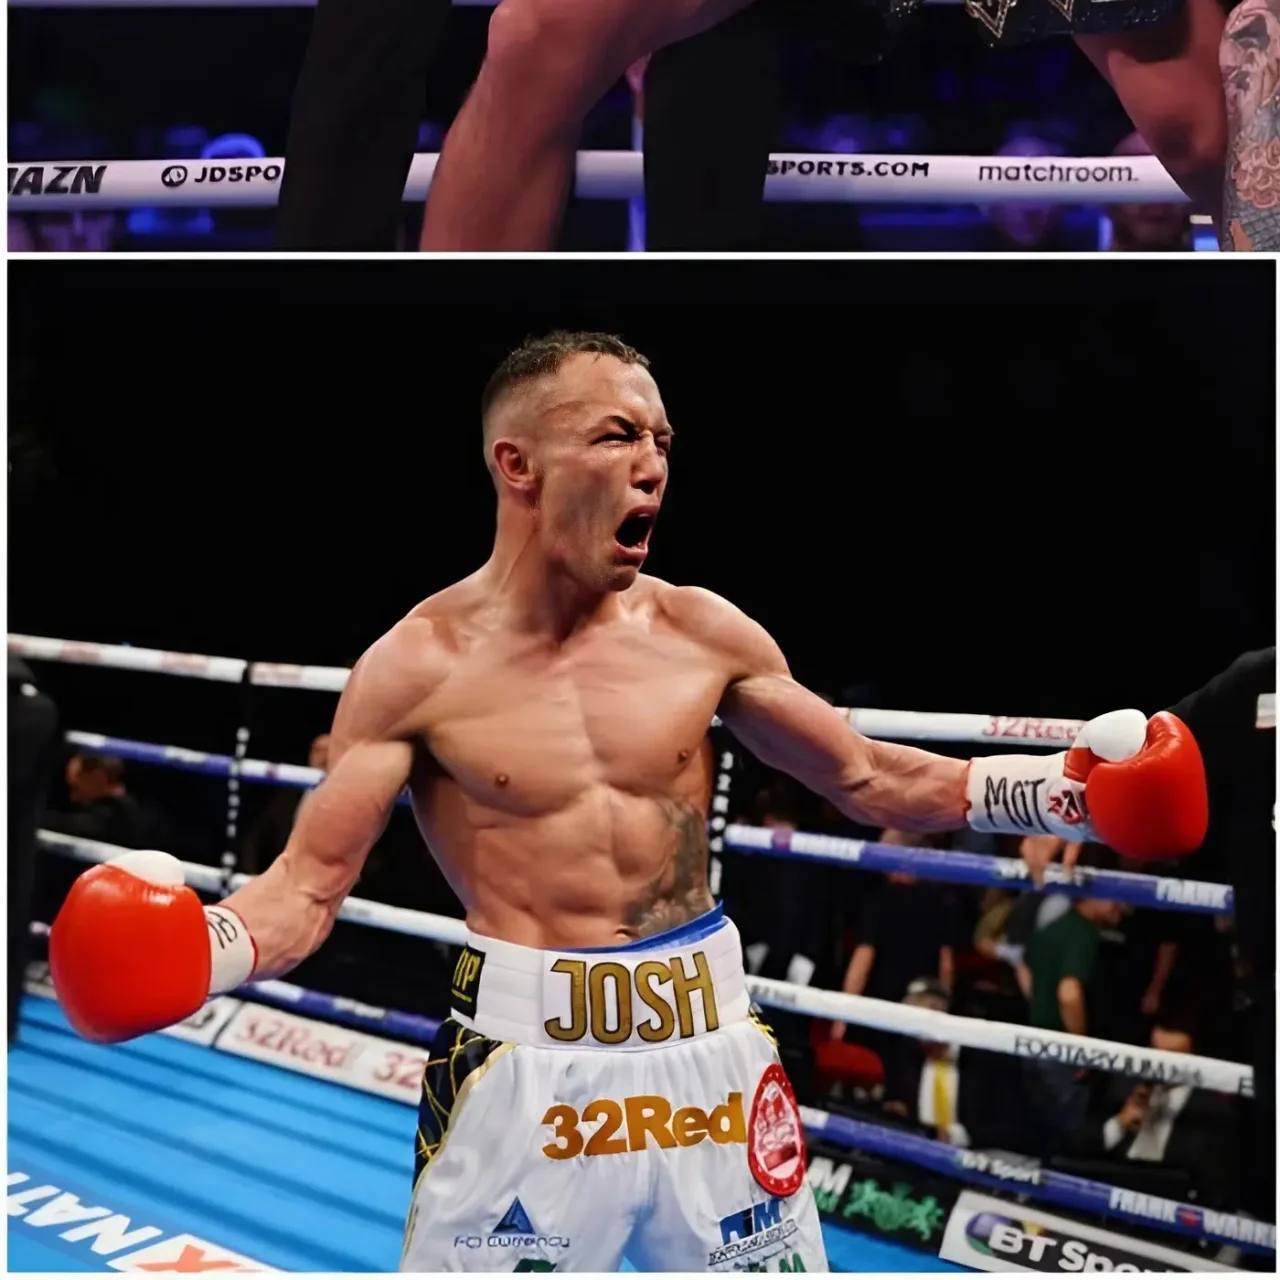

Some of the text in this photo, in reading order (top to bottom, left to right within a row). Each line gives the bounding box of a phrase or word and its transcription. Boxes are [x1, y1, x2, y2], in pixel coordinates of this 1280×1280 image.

[544, 951, 720, 1045] JOSH
[540, 1091, 748, 1160] 32Red
[988, 1222, 1057, 1262] BT
